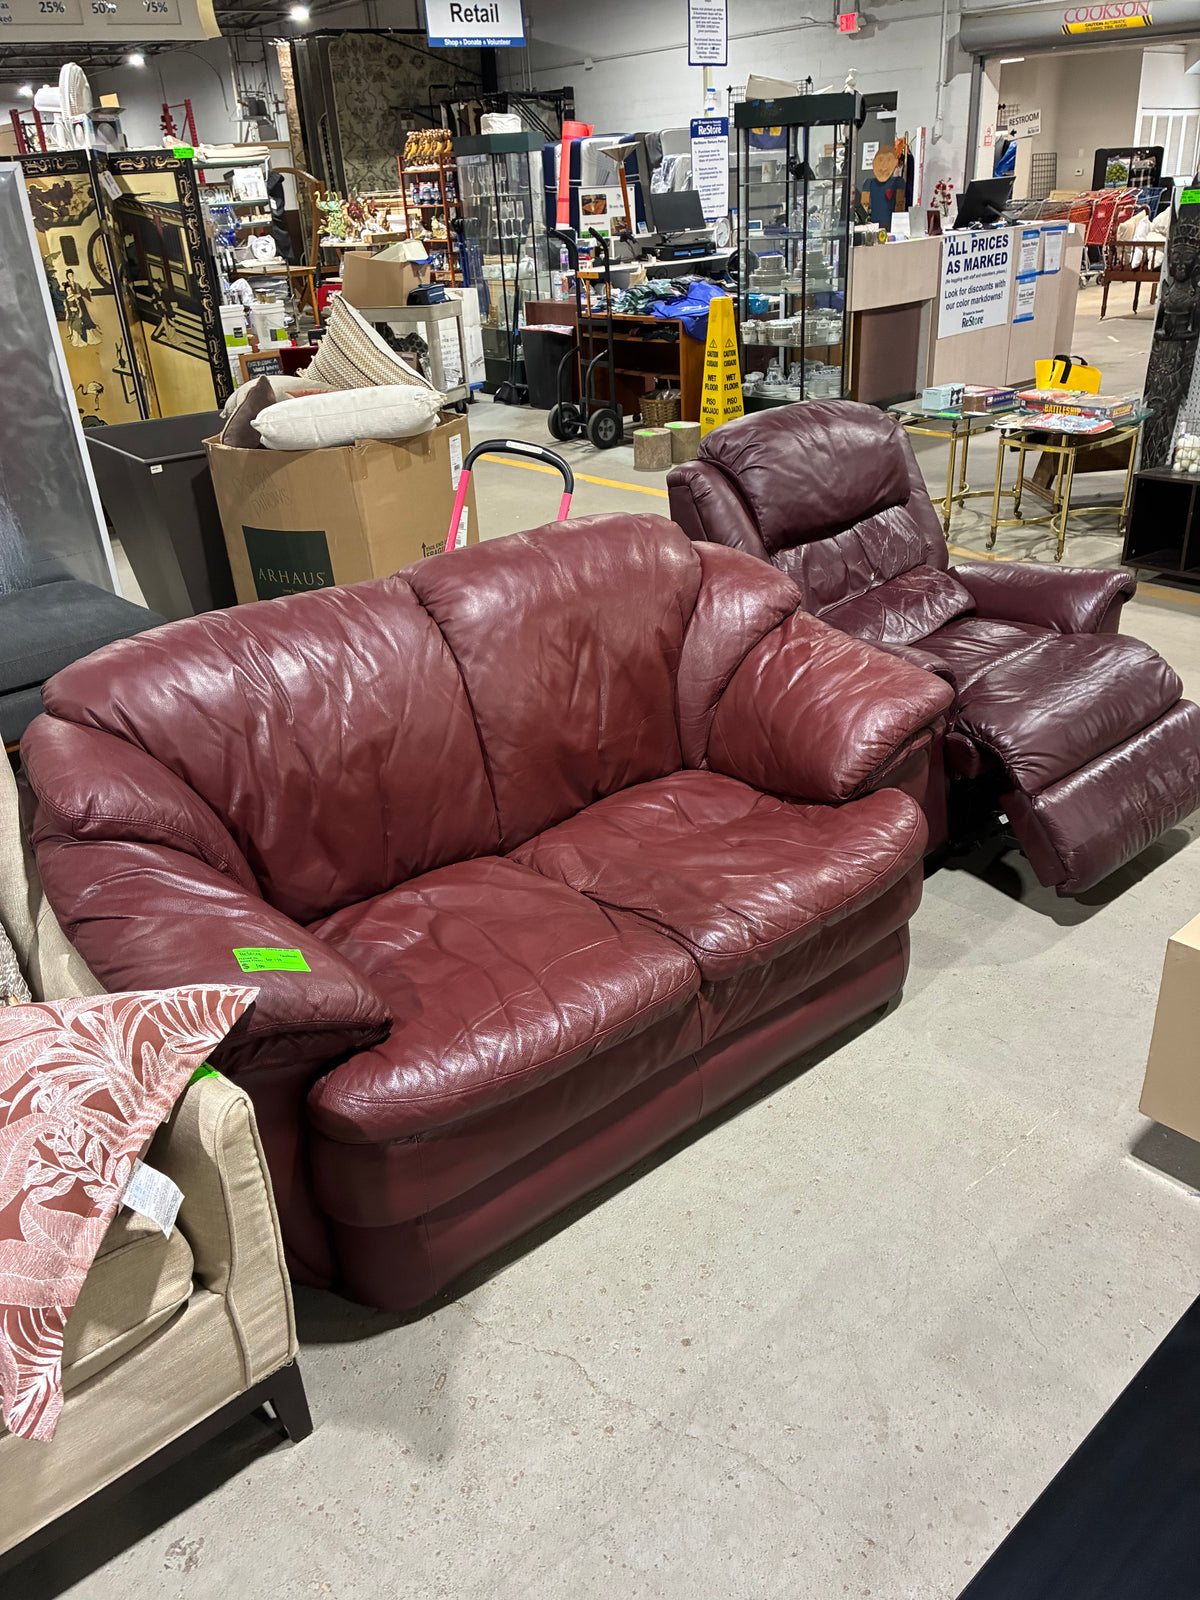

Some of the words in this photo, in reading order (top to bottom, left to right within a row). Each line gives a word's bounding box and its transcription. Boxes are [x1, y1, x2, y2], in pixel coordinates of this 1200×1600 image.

[39, 1, 65, 13] 25%
[91, 3, 116, 14] 50%
[449, 2, 500, 23] Retail
[1064, 2, 1149, 23] COOKSON
[840, 15, 857, 31] EXIT
[444, 38, 459, 47] Shop
[463, 38, 482, 46] Donate
[486, 38, 511, 46] Volunteer
[1008, 111, 1040, 127] RESTROOM
[697, 124, 722, 136] ReStore
[948, 240, 968, 258] ALL
[971, 233, 1009, 253] PRICES
[946, 260, 961, 276] AS
[963, 252, 1008, 272] MARKED
[945, 288, 958, 299] Look
[959, 286, 968, 296] for
[967, 281, 994, 295] discounts
[994, 279, 1007, 289] with
[946, 302, 956, 311] our
[956, 299, 971, 309] color
[970, 290, 1004, 305] markdowns!
[961, 315, 984, 328] ReStore
[724, 382, 739, 391] FLOOR
[727, 397, 737, 405] PISO
[702, 406, 719, 415] MOJADO
[724, 405, 742, 415] MOJADO
[1043, 403, 1082, 416] BATTLESHIP
[426, 546, 446, 557] FRAGI
[258, 567, 326, 587] ARHAUS
